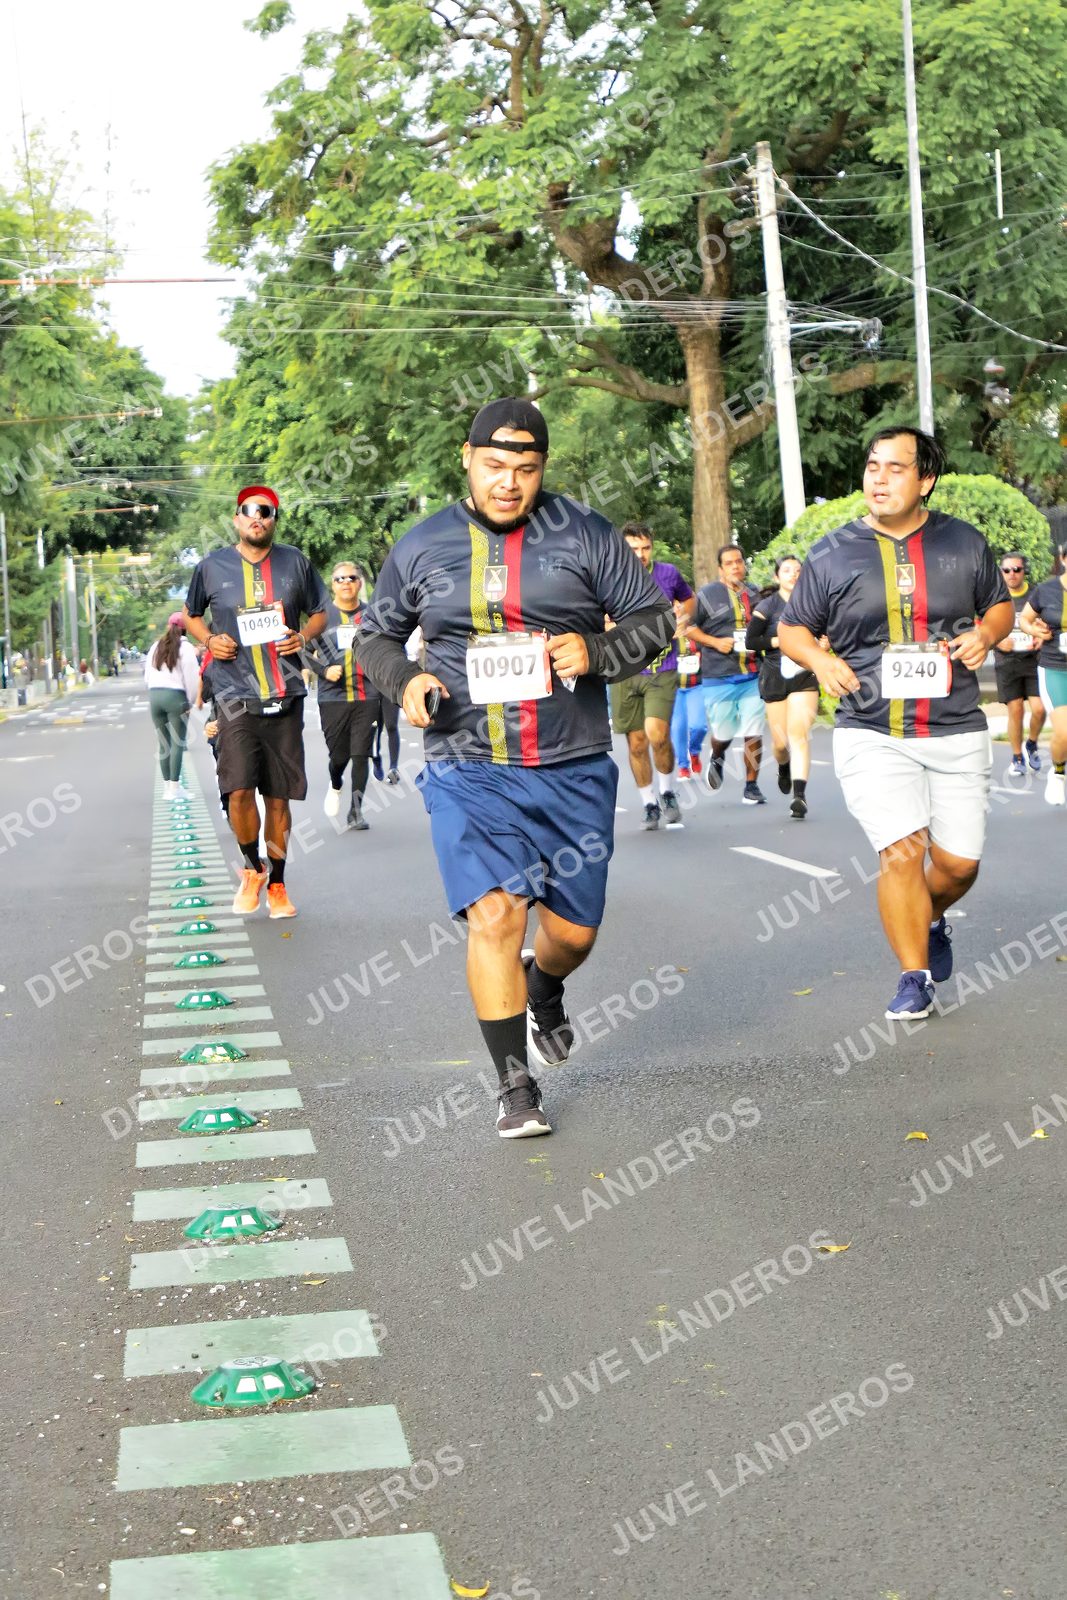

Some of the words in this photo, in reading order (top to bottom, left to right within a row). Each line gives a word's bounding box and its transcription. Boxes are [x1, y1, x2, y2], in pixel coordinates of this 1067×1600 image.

[242, 615, 279, 632] 10496
[471, 654, 537, 679] 10907
[892, 661, 937, 678] 9240
